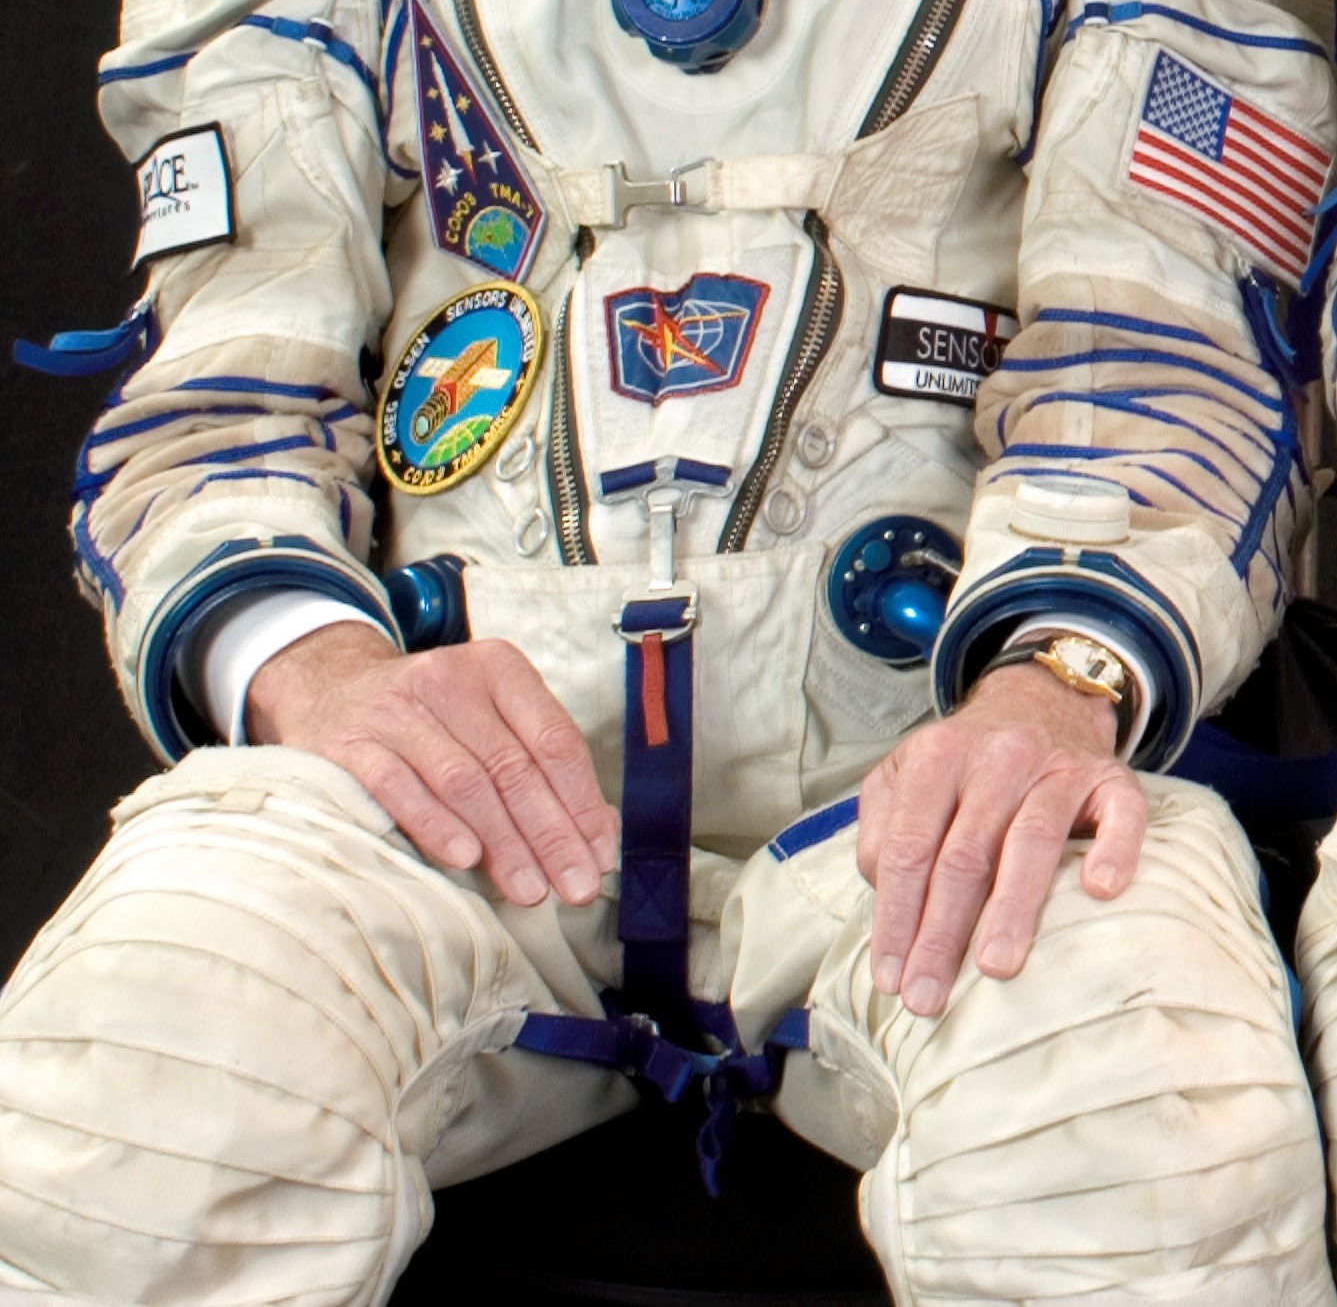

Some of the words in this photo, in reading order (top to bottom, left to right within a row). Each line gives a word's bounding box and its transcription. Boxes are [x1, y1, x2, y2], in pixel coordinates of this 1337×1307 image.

[445, 191, 478, 244] СОЮЗ
[445, 289, 509, 323] SENSORS
[915, 369, 981, 400] UNLIMIT
